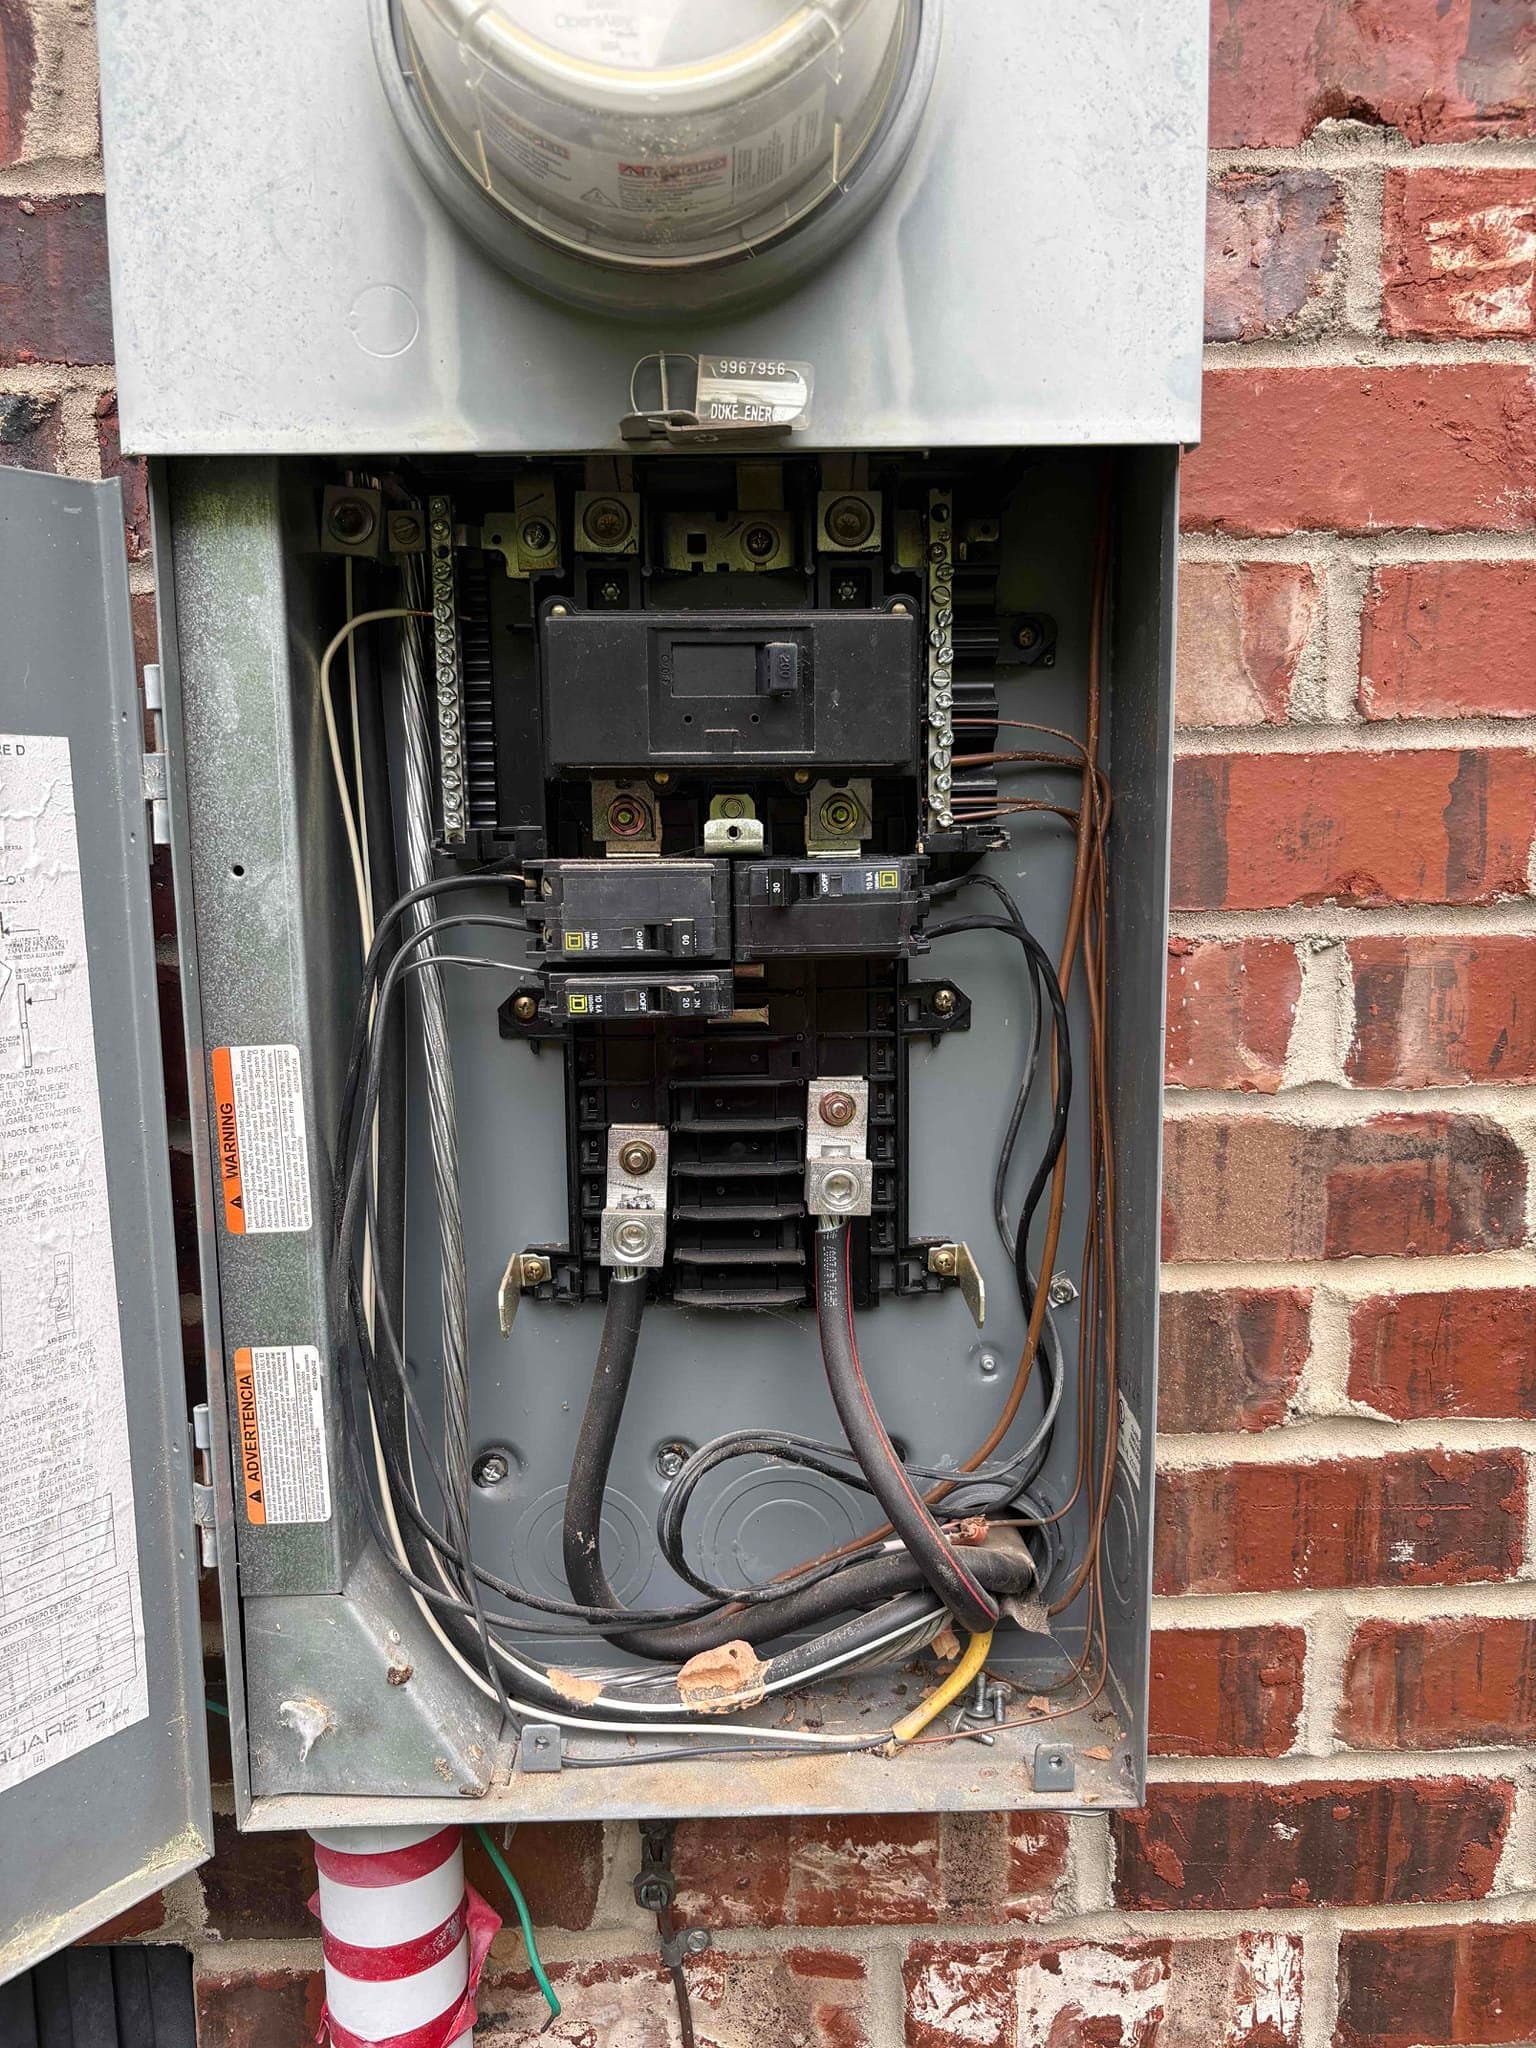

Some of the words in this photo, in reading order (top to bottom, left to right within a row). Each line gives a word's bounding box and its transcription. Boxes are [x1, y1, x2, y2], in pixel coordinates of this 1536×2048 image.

[719, 360, 785, 376] 9967956
[711, 403, 739, 420] DUKE
[780, 654, 791, 679] 200
[772, 882, 781, 894] 30
[591, 932, 599, 941] 10
[681, 934, 690, 946] 60
[594, 995, 602, 1003] 10
[682, 997, 690, 1008] 20
[219, 1102, 238, 1178] WARNING
[239, 1374, 259, 1482] ADVERTENCIA
